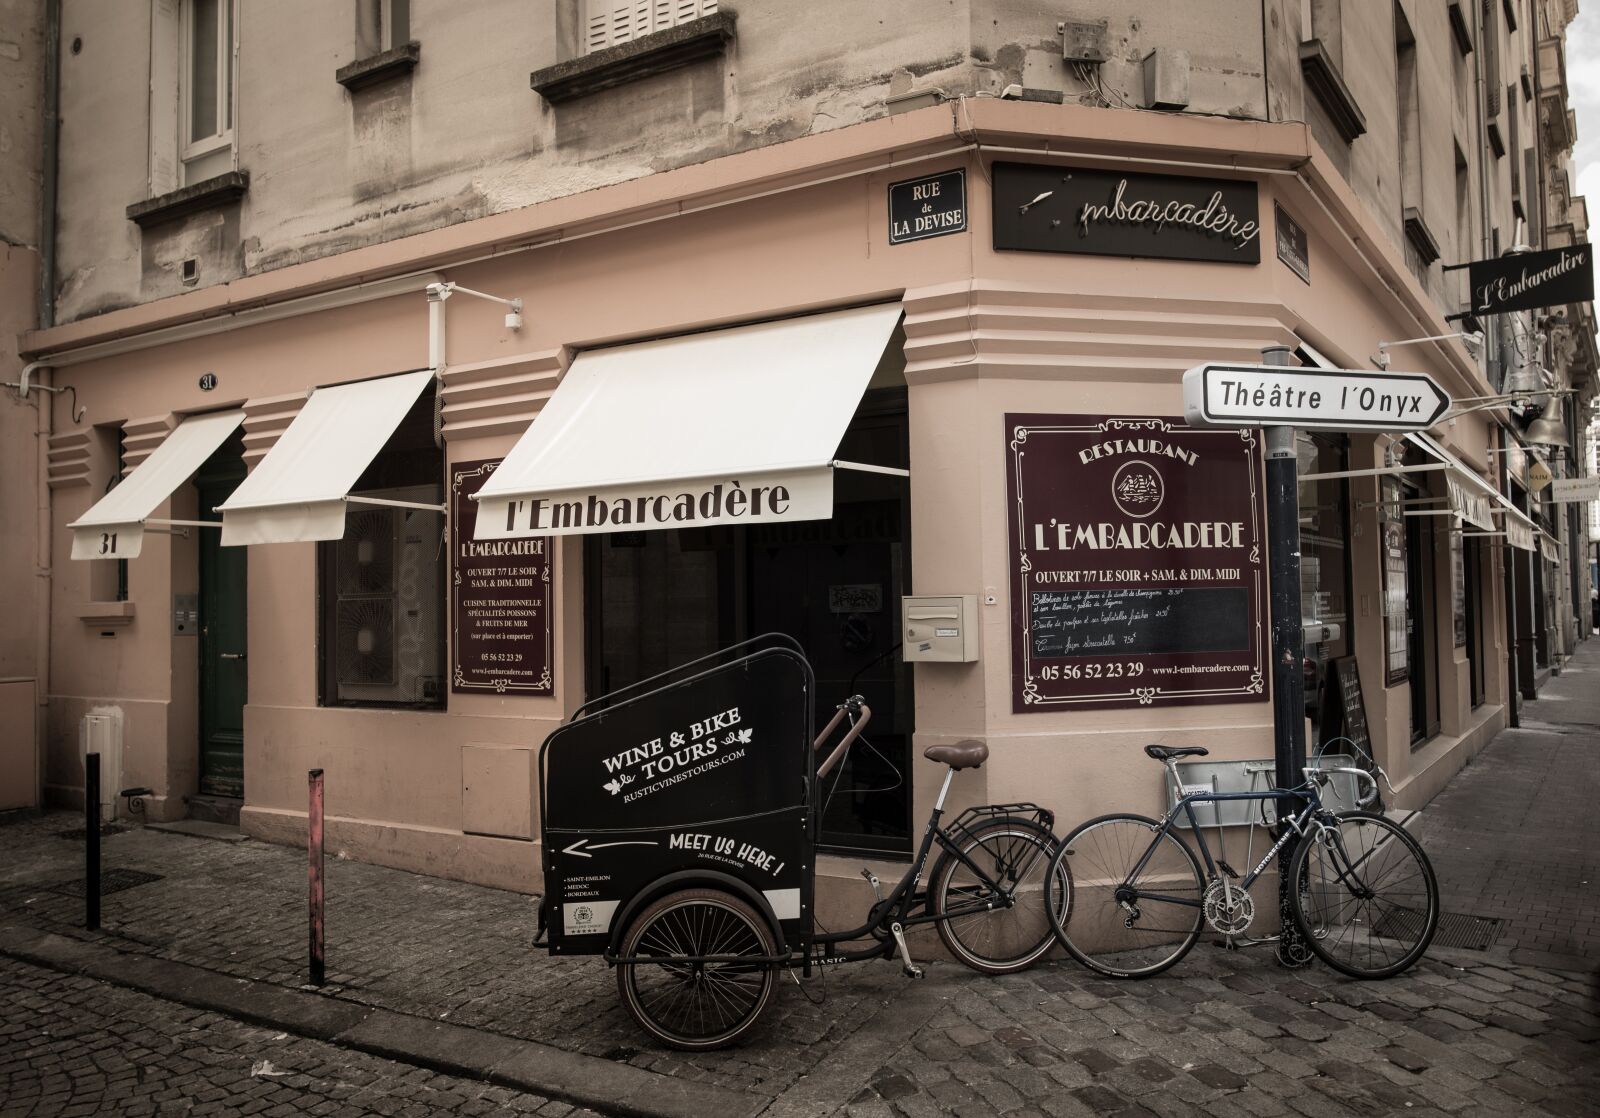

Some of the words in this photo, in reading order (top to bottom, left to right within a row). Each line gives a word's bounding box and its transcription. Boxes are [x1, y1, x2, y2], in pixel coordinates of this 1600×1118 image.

[913, 182, 940, 200] RUE
[921, 203, 932, 213] de
[893, 220, 911, 236] LA
[915, 209, 962, 232] DEVISE
[1476, 251, 1586, 311] L'Embarcadère
[202, 375, 212, 389] 31
[1220, 381, 1322, 410] Théâtre
[1078, 438, 1200, 466] RESTAURANT
[506, 480, 790, 532] l'Embarcadère
[99, 532, 117, 554] 31
[1035, 518, 1245, 551] L'EMBARCADERE
[461, 540, 544, 557] L'EMBARCADERE
[467, 568, 496, 576] OUVERT
[497, 568, 507, 576] 7/7
[508, 567, 518, 576] LE
[519, 567, 537, 575] SOIR
[1035, 570, 1081, 583] OUVERT
[1082, 570, 1097, 583] 7/7
[1099, 570, 1114, 582] LE
[1115, 569, 1141, 582] SOIR
[1143, 572, 1150, 580] +
[1151, 569, 1178, 581] SAM.
[1179, 569, 1188, 581] &
[1190, 568, 1214, 581] DIM.
[1215, 568, 1241, 580] MIDI
[471, 579, 489, 587] SAM.
[489, 579, 496, 587] &
[497, 579, 514, 587] DIM.
[515, 578, 533, 587] MIDI
[463, 599, 487, 607] CUISINE
[487, 599, 542, 607] TRADITIONNELLE
[467, 608, 505, 617] SPÉCIALITÉS
[506, 609, 537, 617] POISSONS
[506, 633, 533, 641] emporter)
[515, 654, 522, 662] 29
[472, 668, 533, 676] www.l-embarcadere.com
[1041, 665, 1059, 680] 05
[1063, 664, 1080, 680] 56
[1084, 663, 1102, 678] 52
[1106, 662, 1123, 678] 23
[1127, 662, 1144, 677] 29
[1152, 663, 1250, 676] www.l-embarcadere.com
[602, 738, 664, 774] WINE
[669, 731, 686, 748] &
[689, 707, 742, 741] BIKE
[641, 737, 718, 780] TOURS
[623, 749, 746, 803] RUSTICVINESTOURS.COM
[669, 833, 712, 851] MEET
[714, 836, 735, 855] US
[737, 843, 776, 871] HERE
[773, 862, 785, 876] !
[1253, 831, 1290, 875] MOTOBECANE
[728, 858, 745, 869] DEVISE
[566, 874, 611, 883] SAINT-EMILION
[567, 890, 600, 898] BORDEAUX
[810, 957, 847, 966] BASIC
